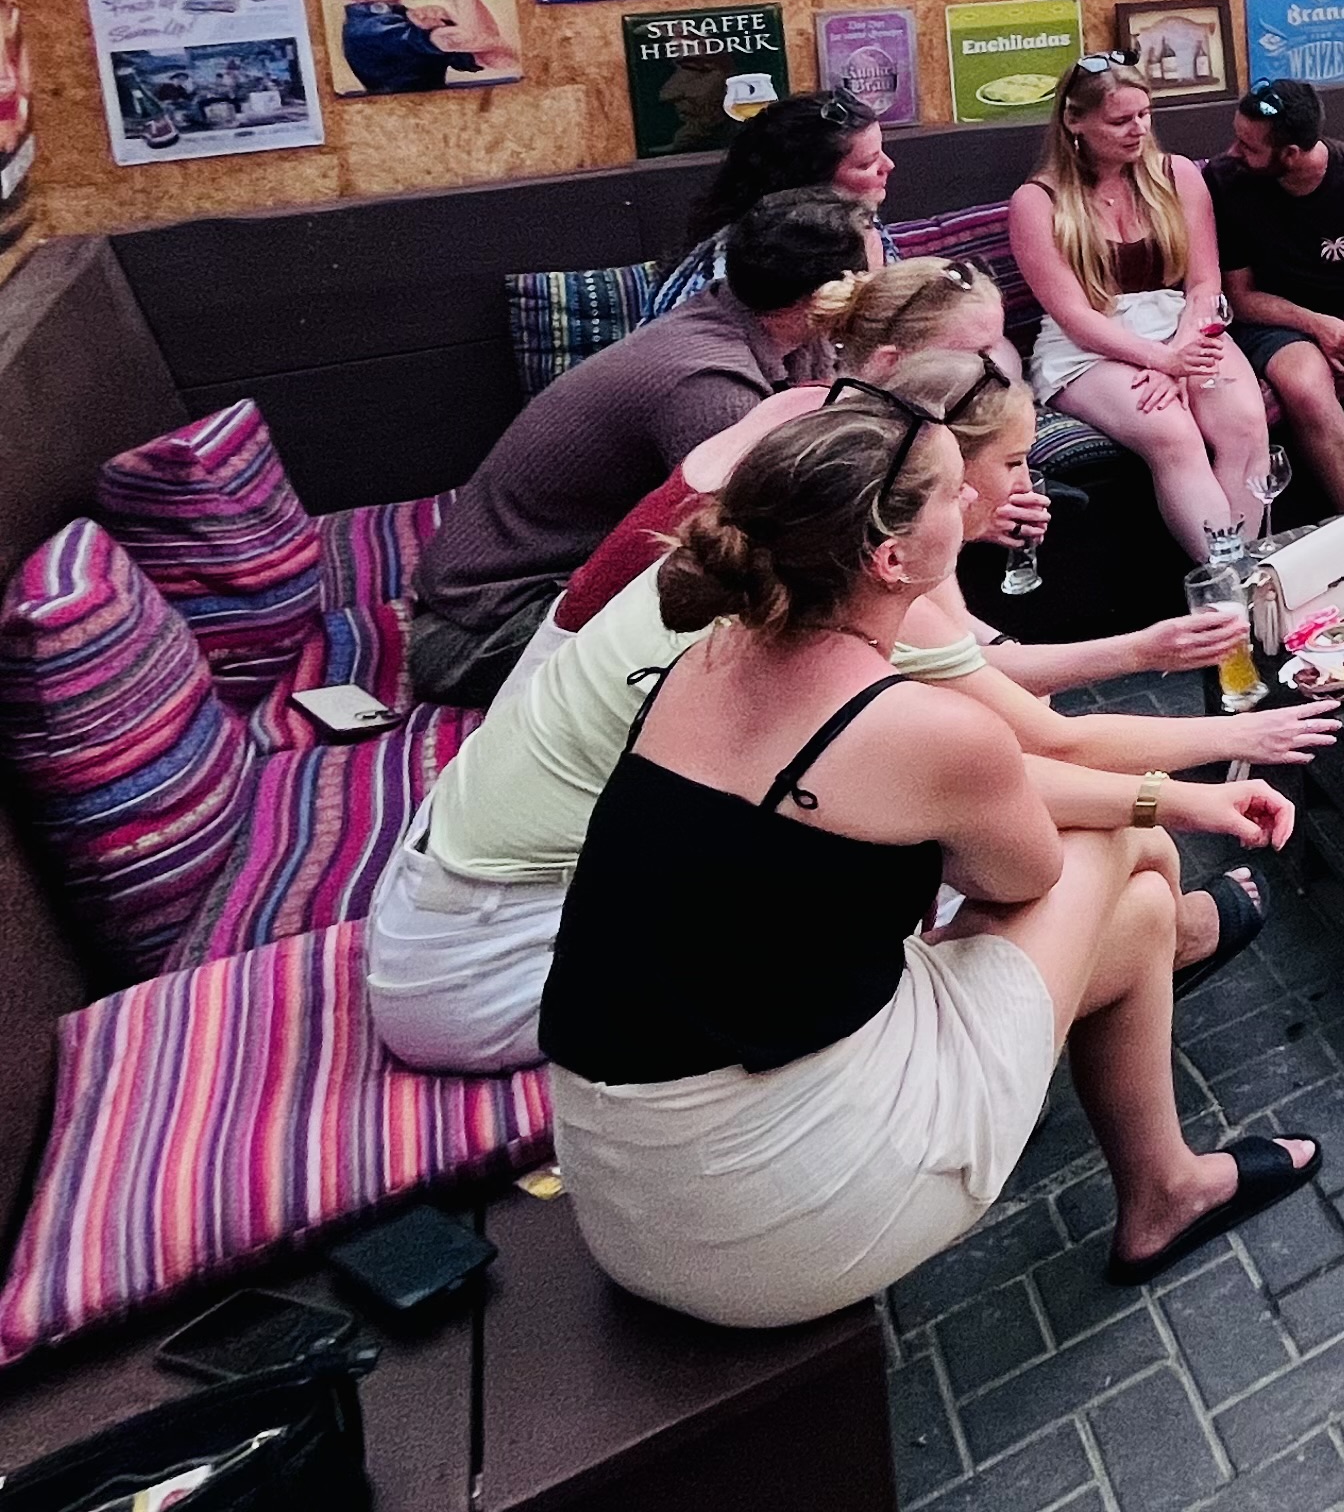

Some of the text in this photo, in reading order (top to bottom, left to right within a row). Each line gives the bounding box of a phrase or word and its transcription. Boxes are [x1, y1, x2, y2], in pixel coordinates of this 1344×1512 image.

[646, 13, 766, 39] STRAFFE
[640, 31, 779, 61] HENDRIK
[962, 31, 1071, 55] Enchiladas
